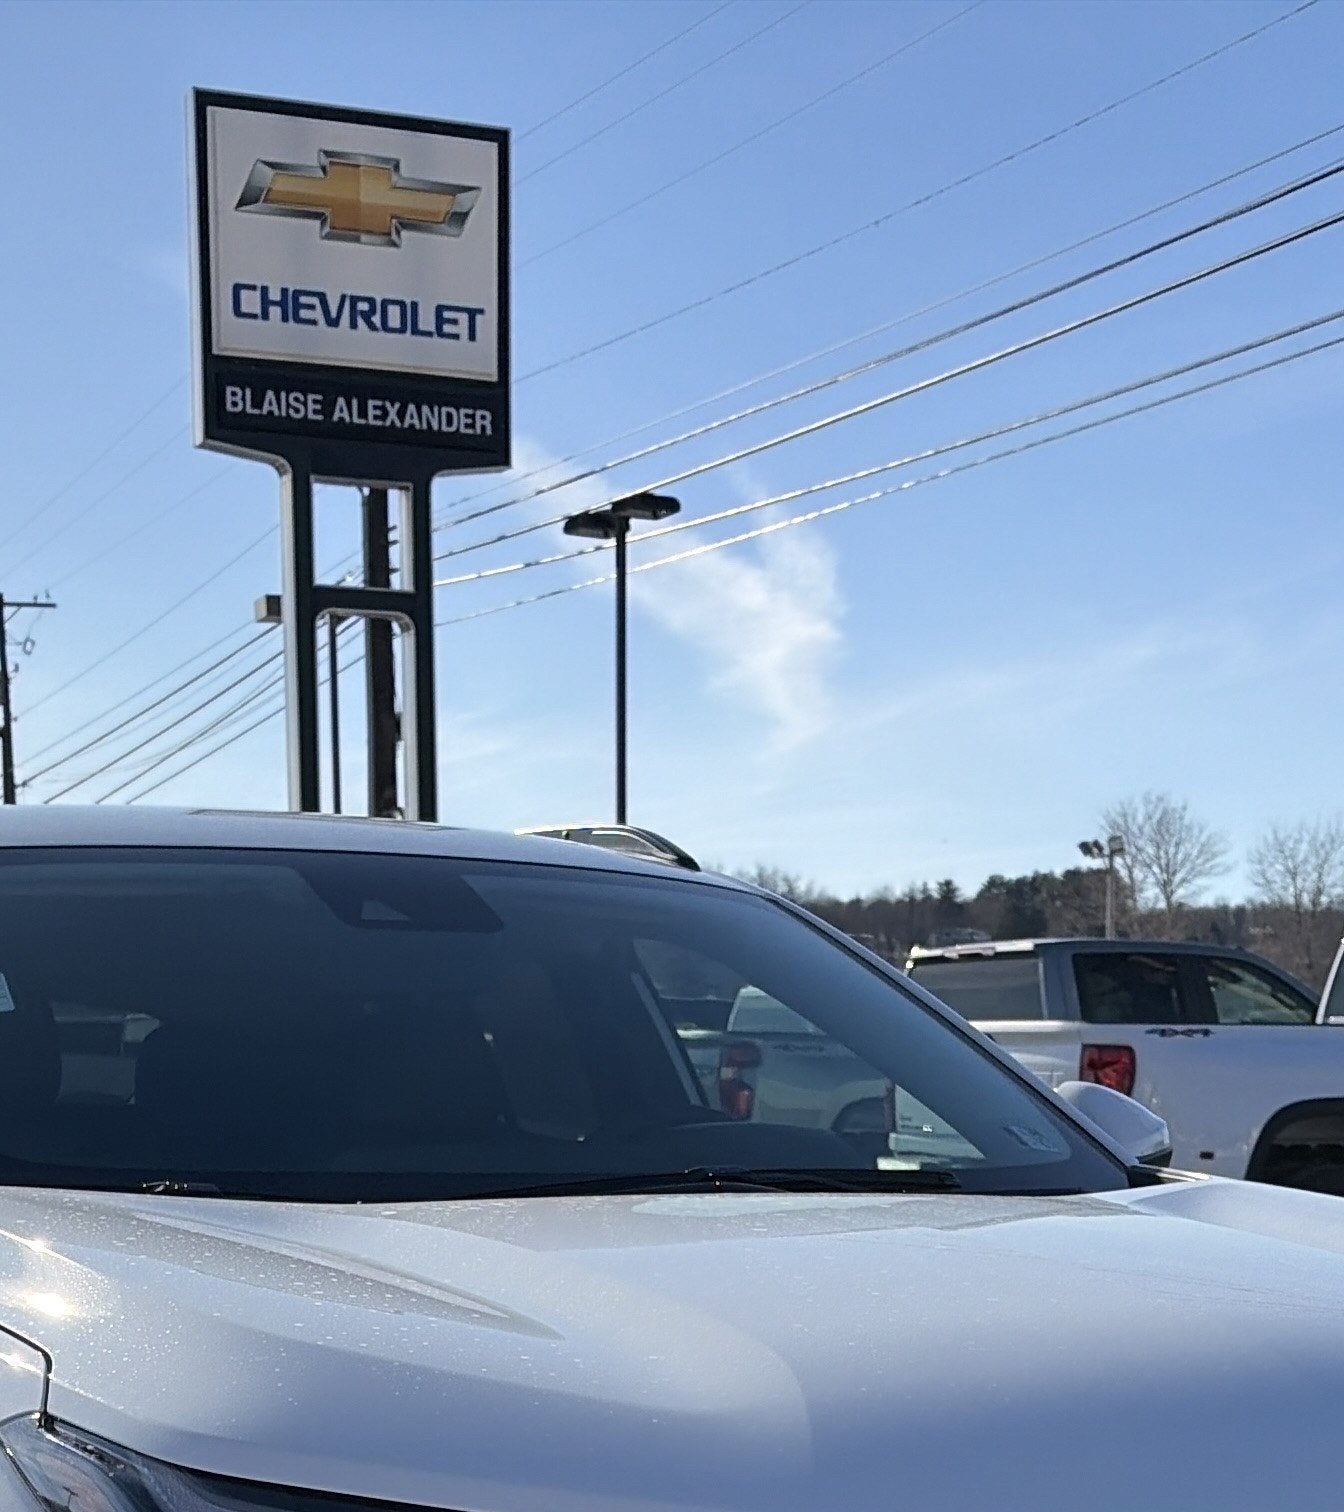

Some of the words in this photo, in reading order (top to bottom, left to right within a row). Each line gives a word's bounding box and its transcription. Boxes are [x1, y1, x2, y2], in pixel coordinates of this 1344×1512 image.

[231, 282, 485, 342] CHEVROLET
[225, 386, 324, 421] BLAISE
[333, 396, 493, 435] ALEXANDER
